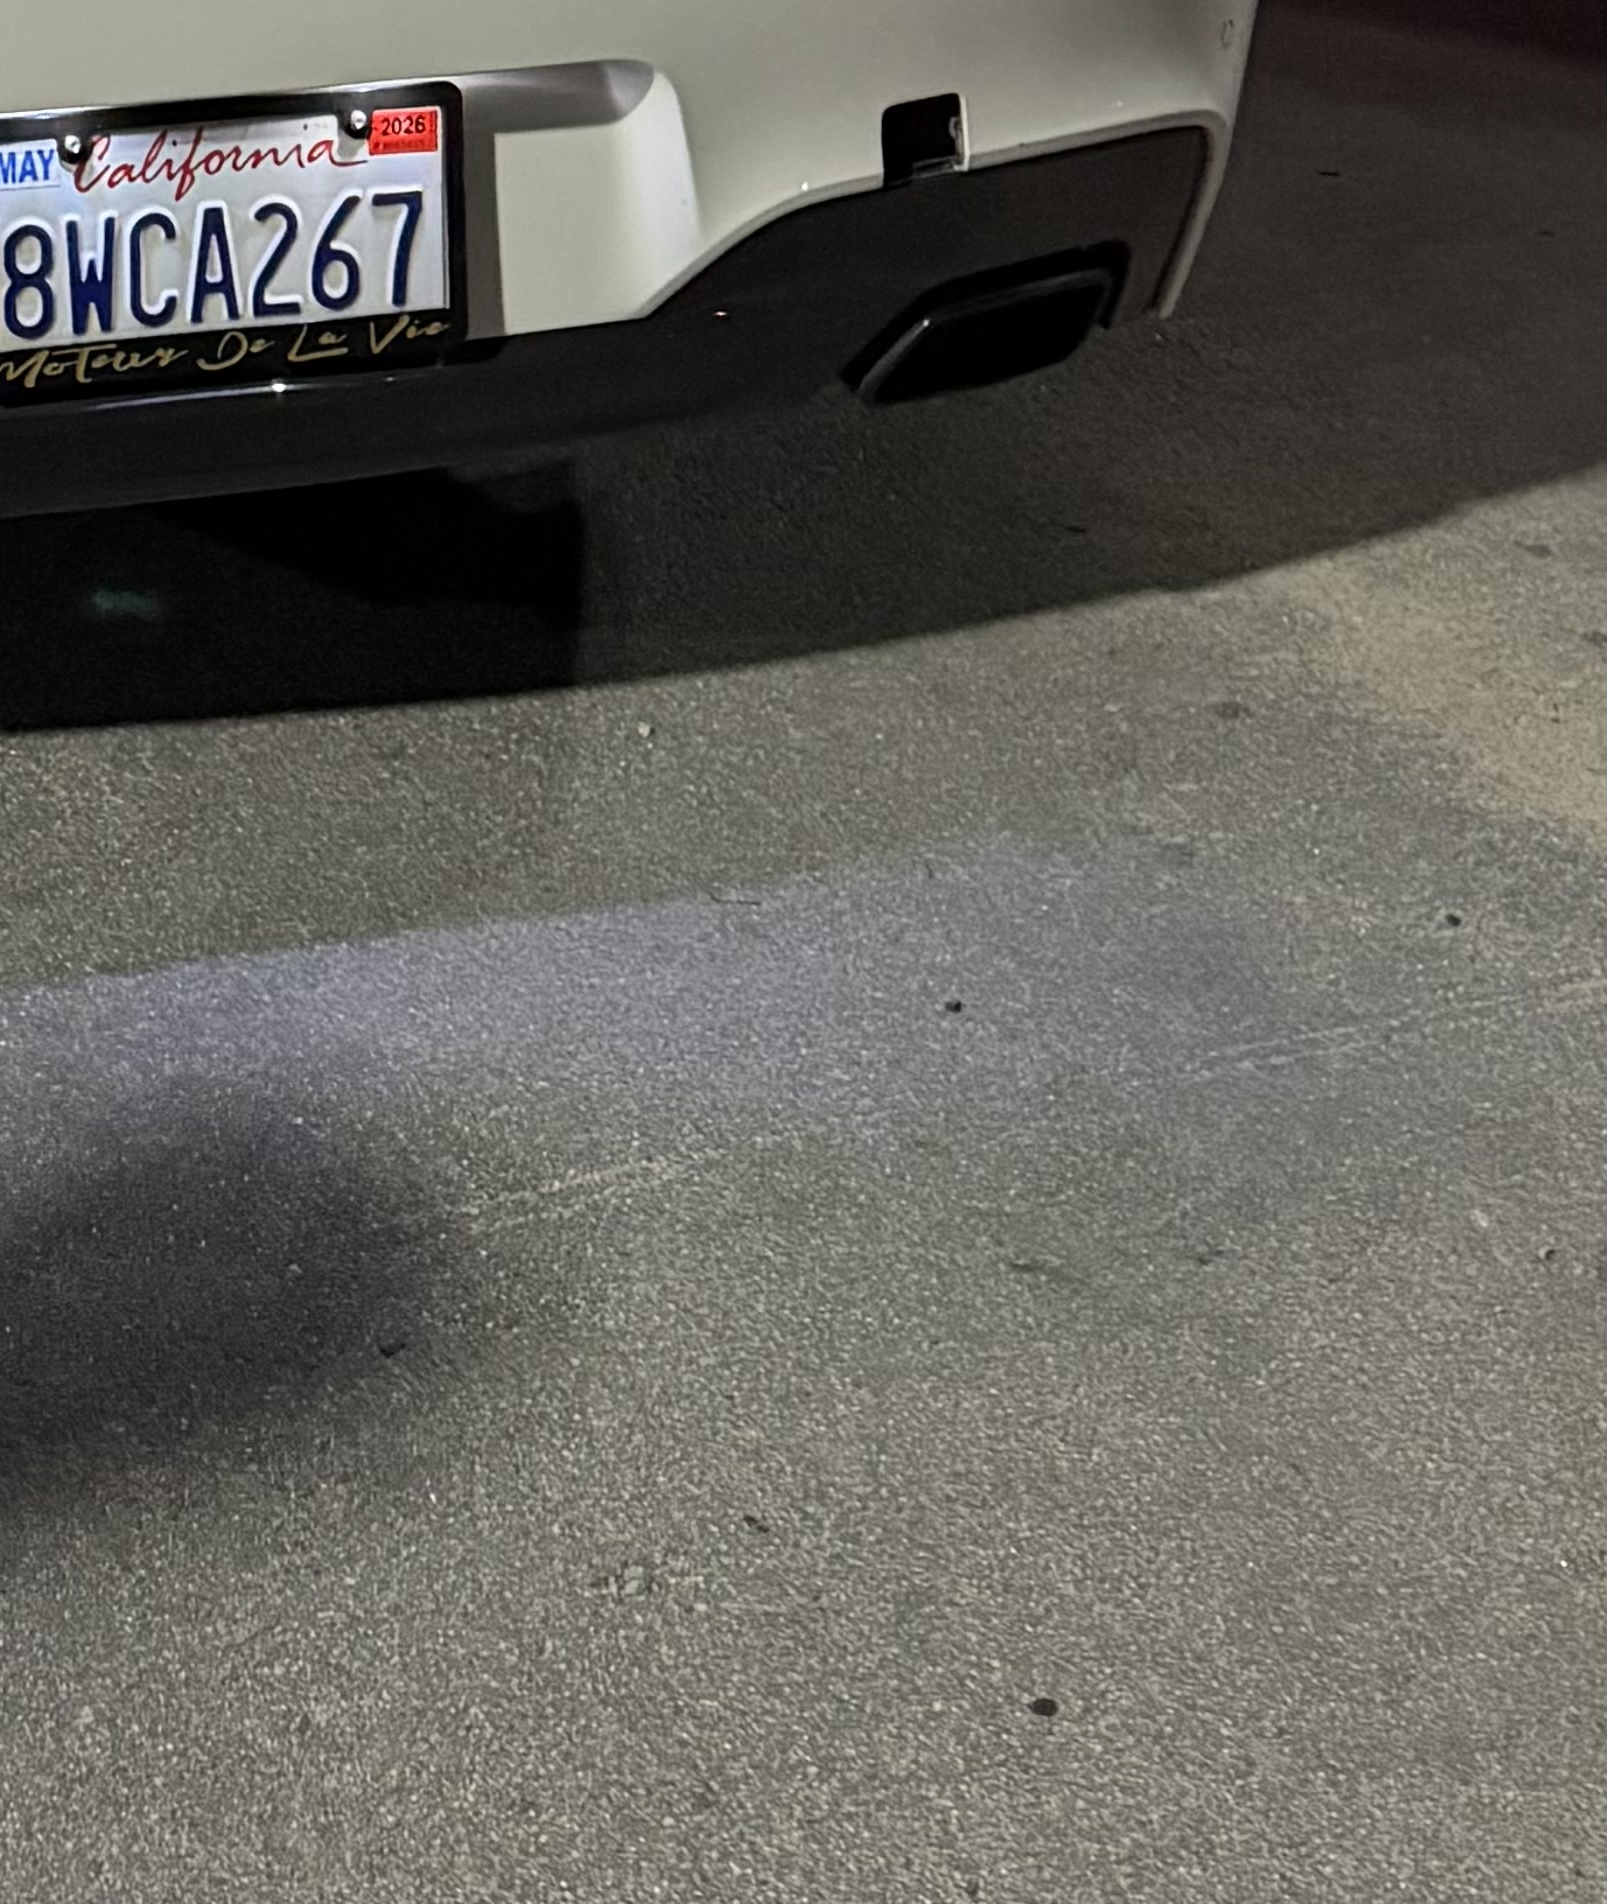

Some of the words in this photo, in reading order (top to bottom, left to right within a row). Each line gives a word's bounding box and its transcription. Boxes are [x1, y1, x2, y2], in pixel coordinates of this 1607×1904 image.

[74, 127, 368, 202] California
[379, 115, 425, 136] 2026
[3, 192, 424, 340] 8WCA267
[288, 323, 349, 362] La
